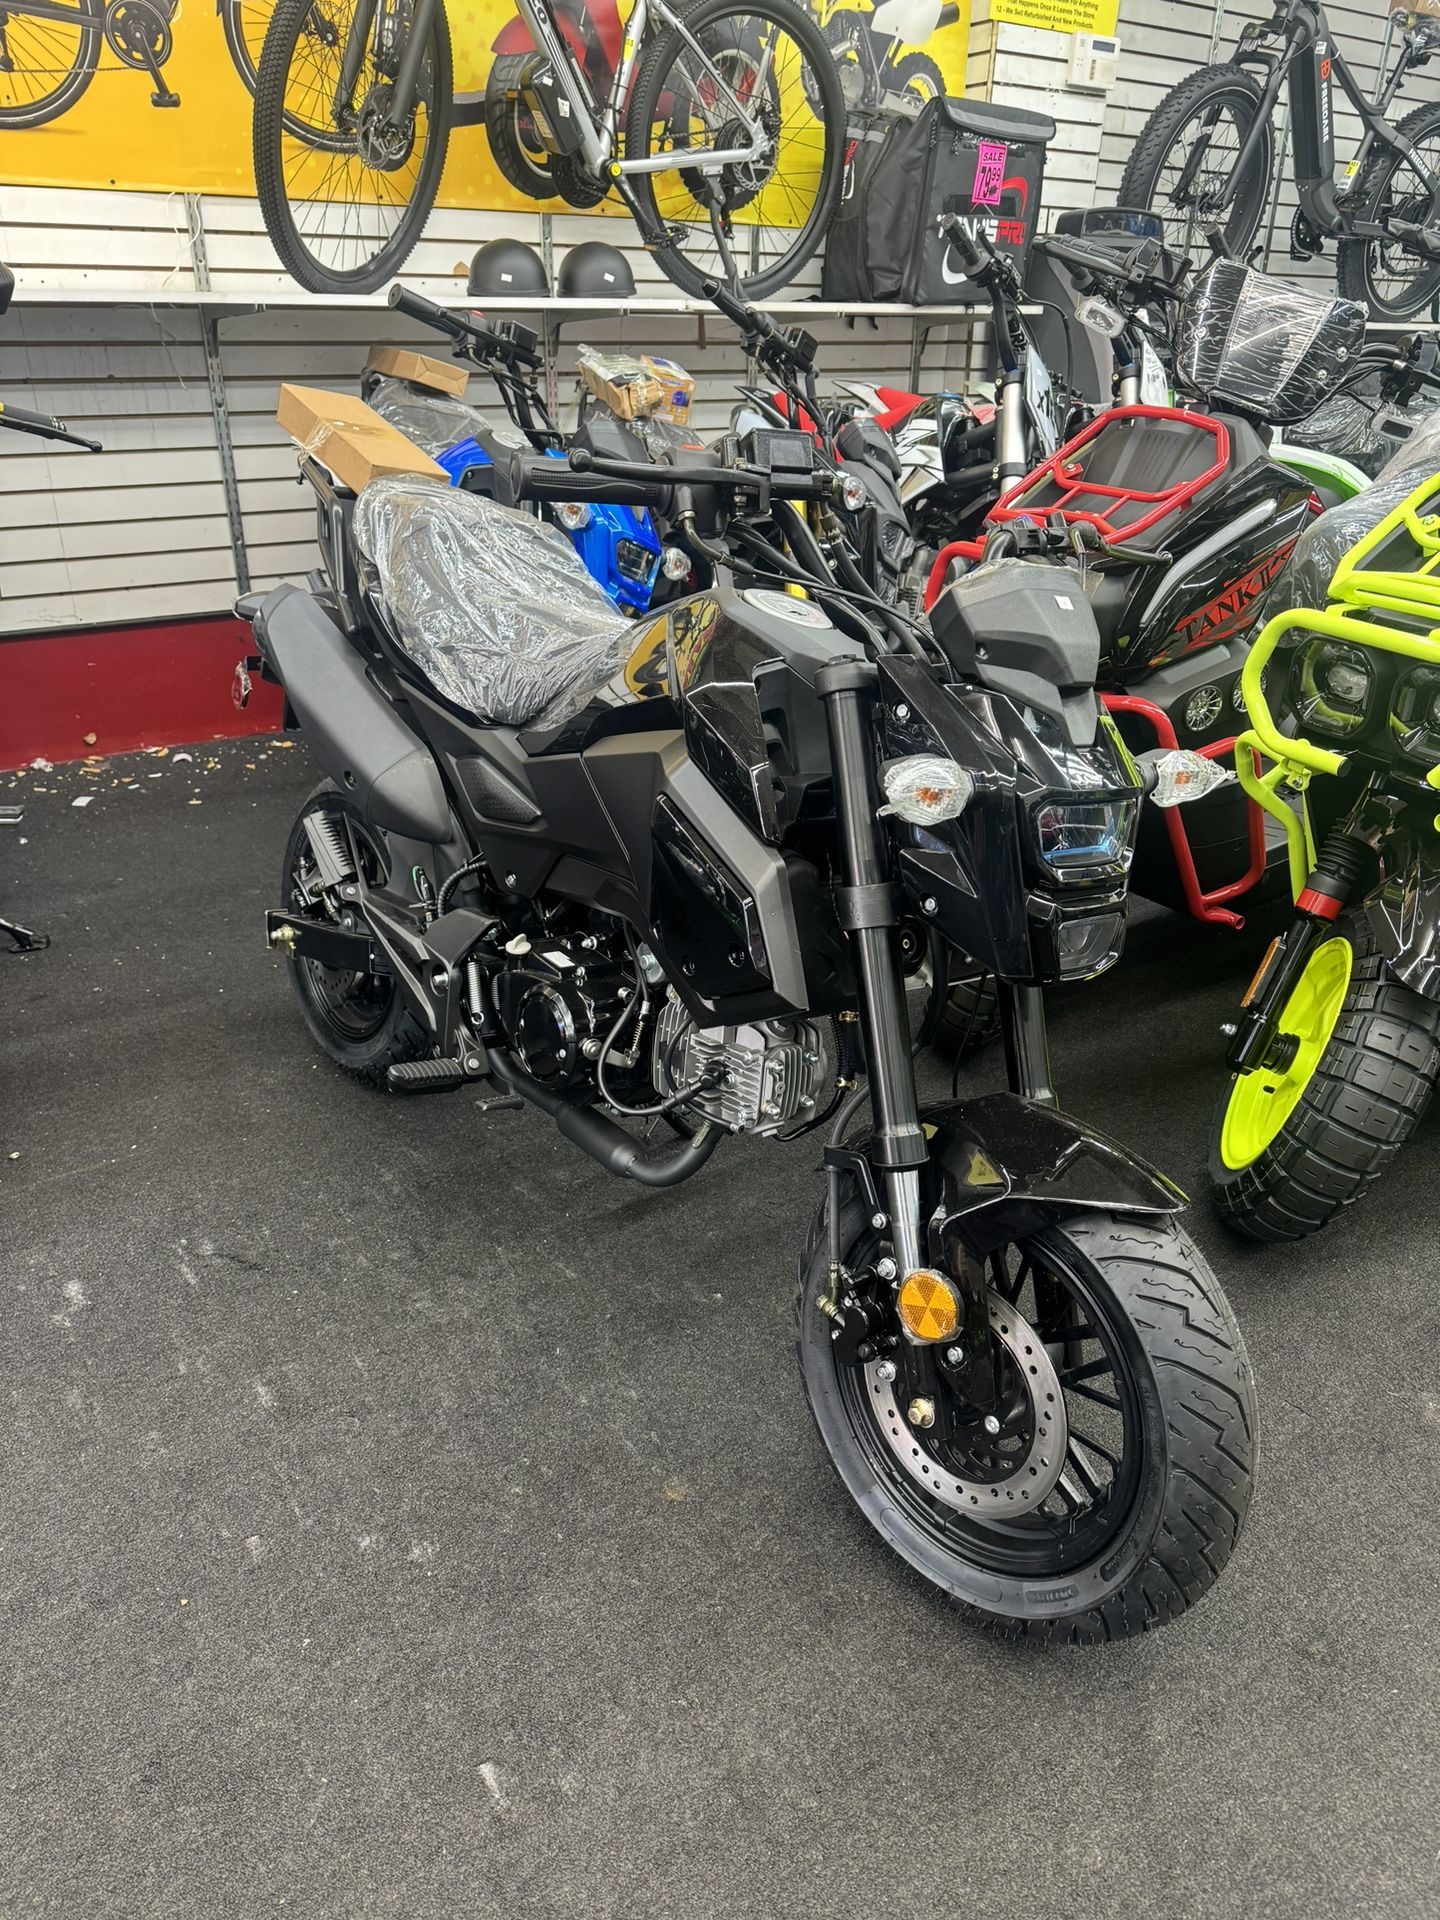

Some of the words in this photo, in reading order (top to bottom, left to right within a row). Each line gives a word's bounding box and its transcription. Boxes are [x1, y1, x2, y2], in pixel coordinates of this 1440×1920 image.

[1005, 7, 1014, 15] We
[1014, 8, 1023, 16] Sell
[1024, 10, 1051, 21] Refurbished
[1018, 0, 1039, 8] Happens
[1040, 2, 1052, 11] Once
[1056, 6, 1073, 15] Leaves
[1073, 8, 1082, 16] The
[982, 152, 1004, 161] SALE
[1177, 577, 1257, 643] TANK
